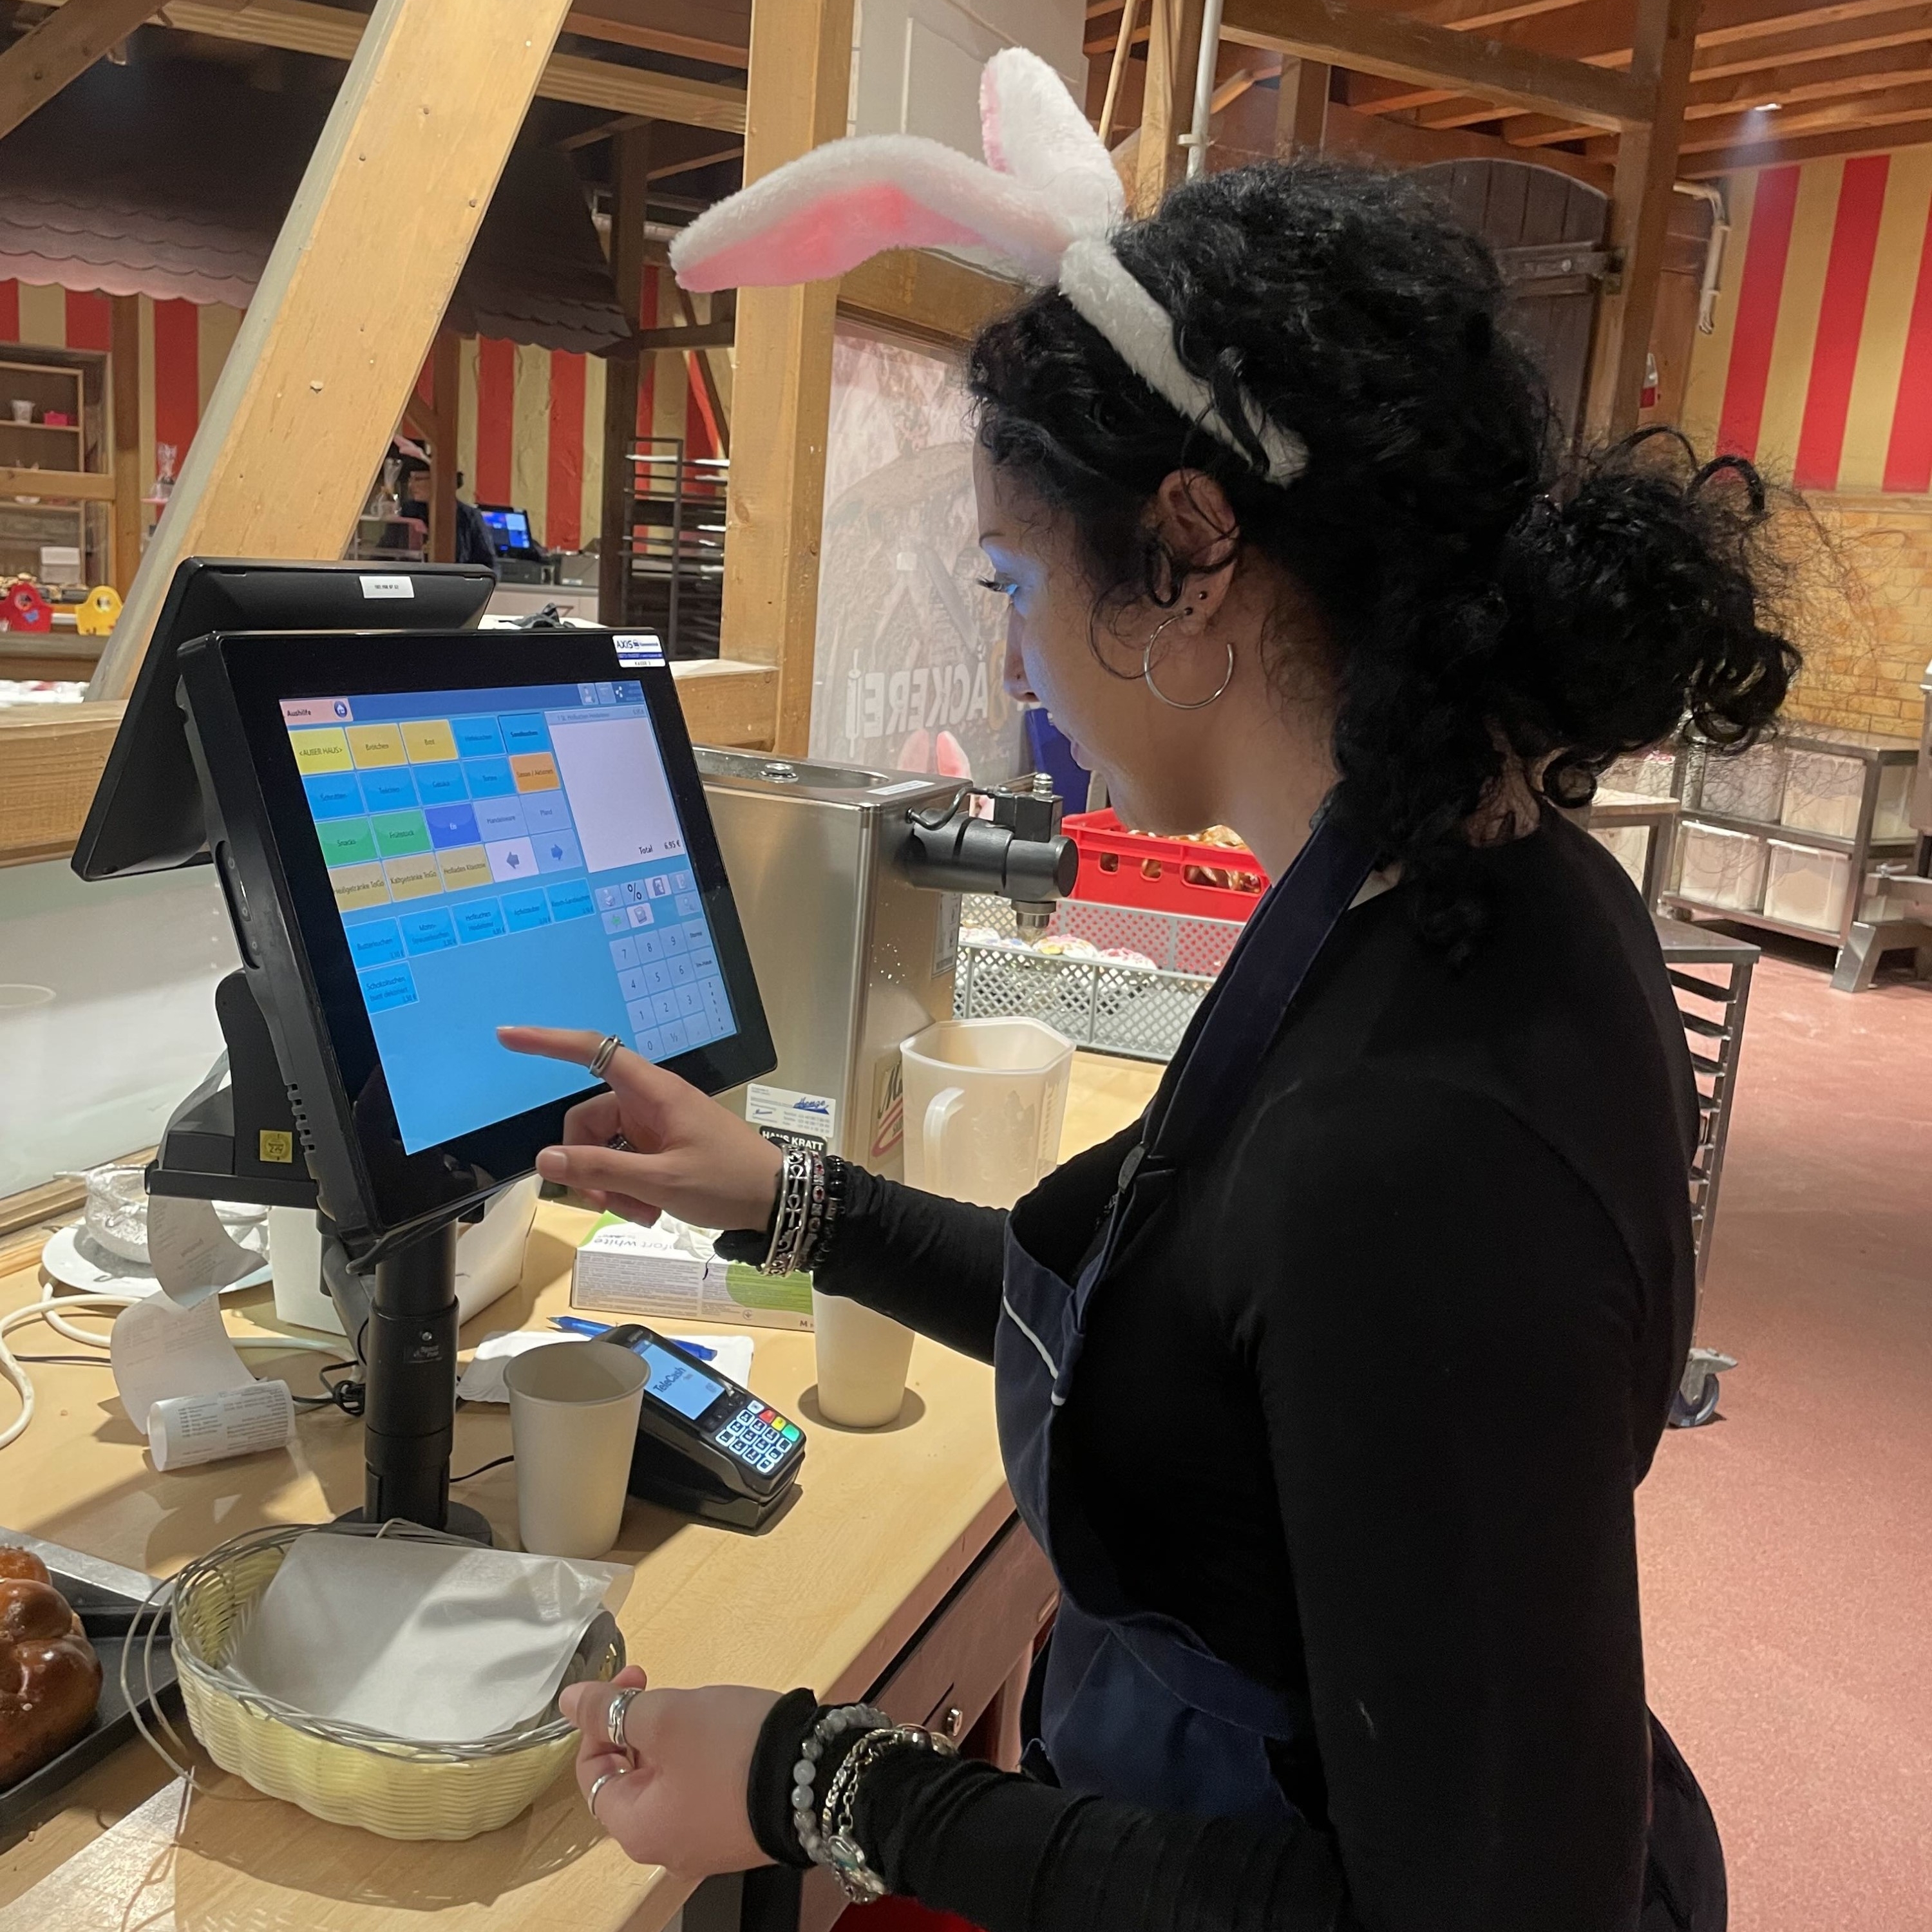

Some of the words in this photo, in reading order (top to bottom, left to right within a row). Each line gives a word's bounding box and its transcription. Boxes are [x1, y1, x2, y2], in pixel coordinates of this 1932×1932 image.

[617, 640, 633, 649] AXIS
[639, 846, 653, 855] Total
[423, 871, 437, 879] ToGo
[370, 879, 385, 889] ToGo
[670, 936, 676, 946] 9
[647, 943, 652, 952] 8
[621, 949, 627, 960] 7
[679, 965, 685, 974] 6
[655, 972, 661, 983] 5
[630, 980, 636, 989] 4
[687, 995, 692, 1005] 3
[663, 1003, 669, 1012] 2
[639, 1011, 644, 1020] 1
[647, 1041, 653, 1050] 0
[791, 1137, 824, 1151] KRATT
[594, 1236, 636, 1248] white
[653, 1367, 686, 1393] TeleCash
